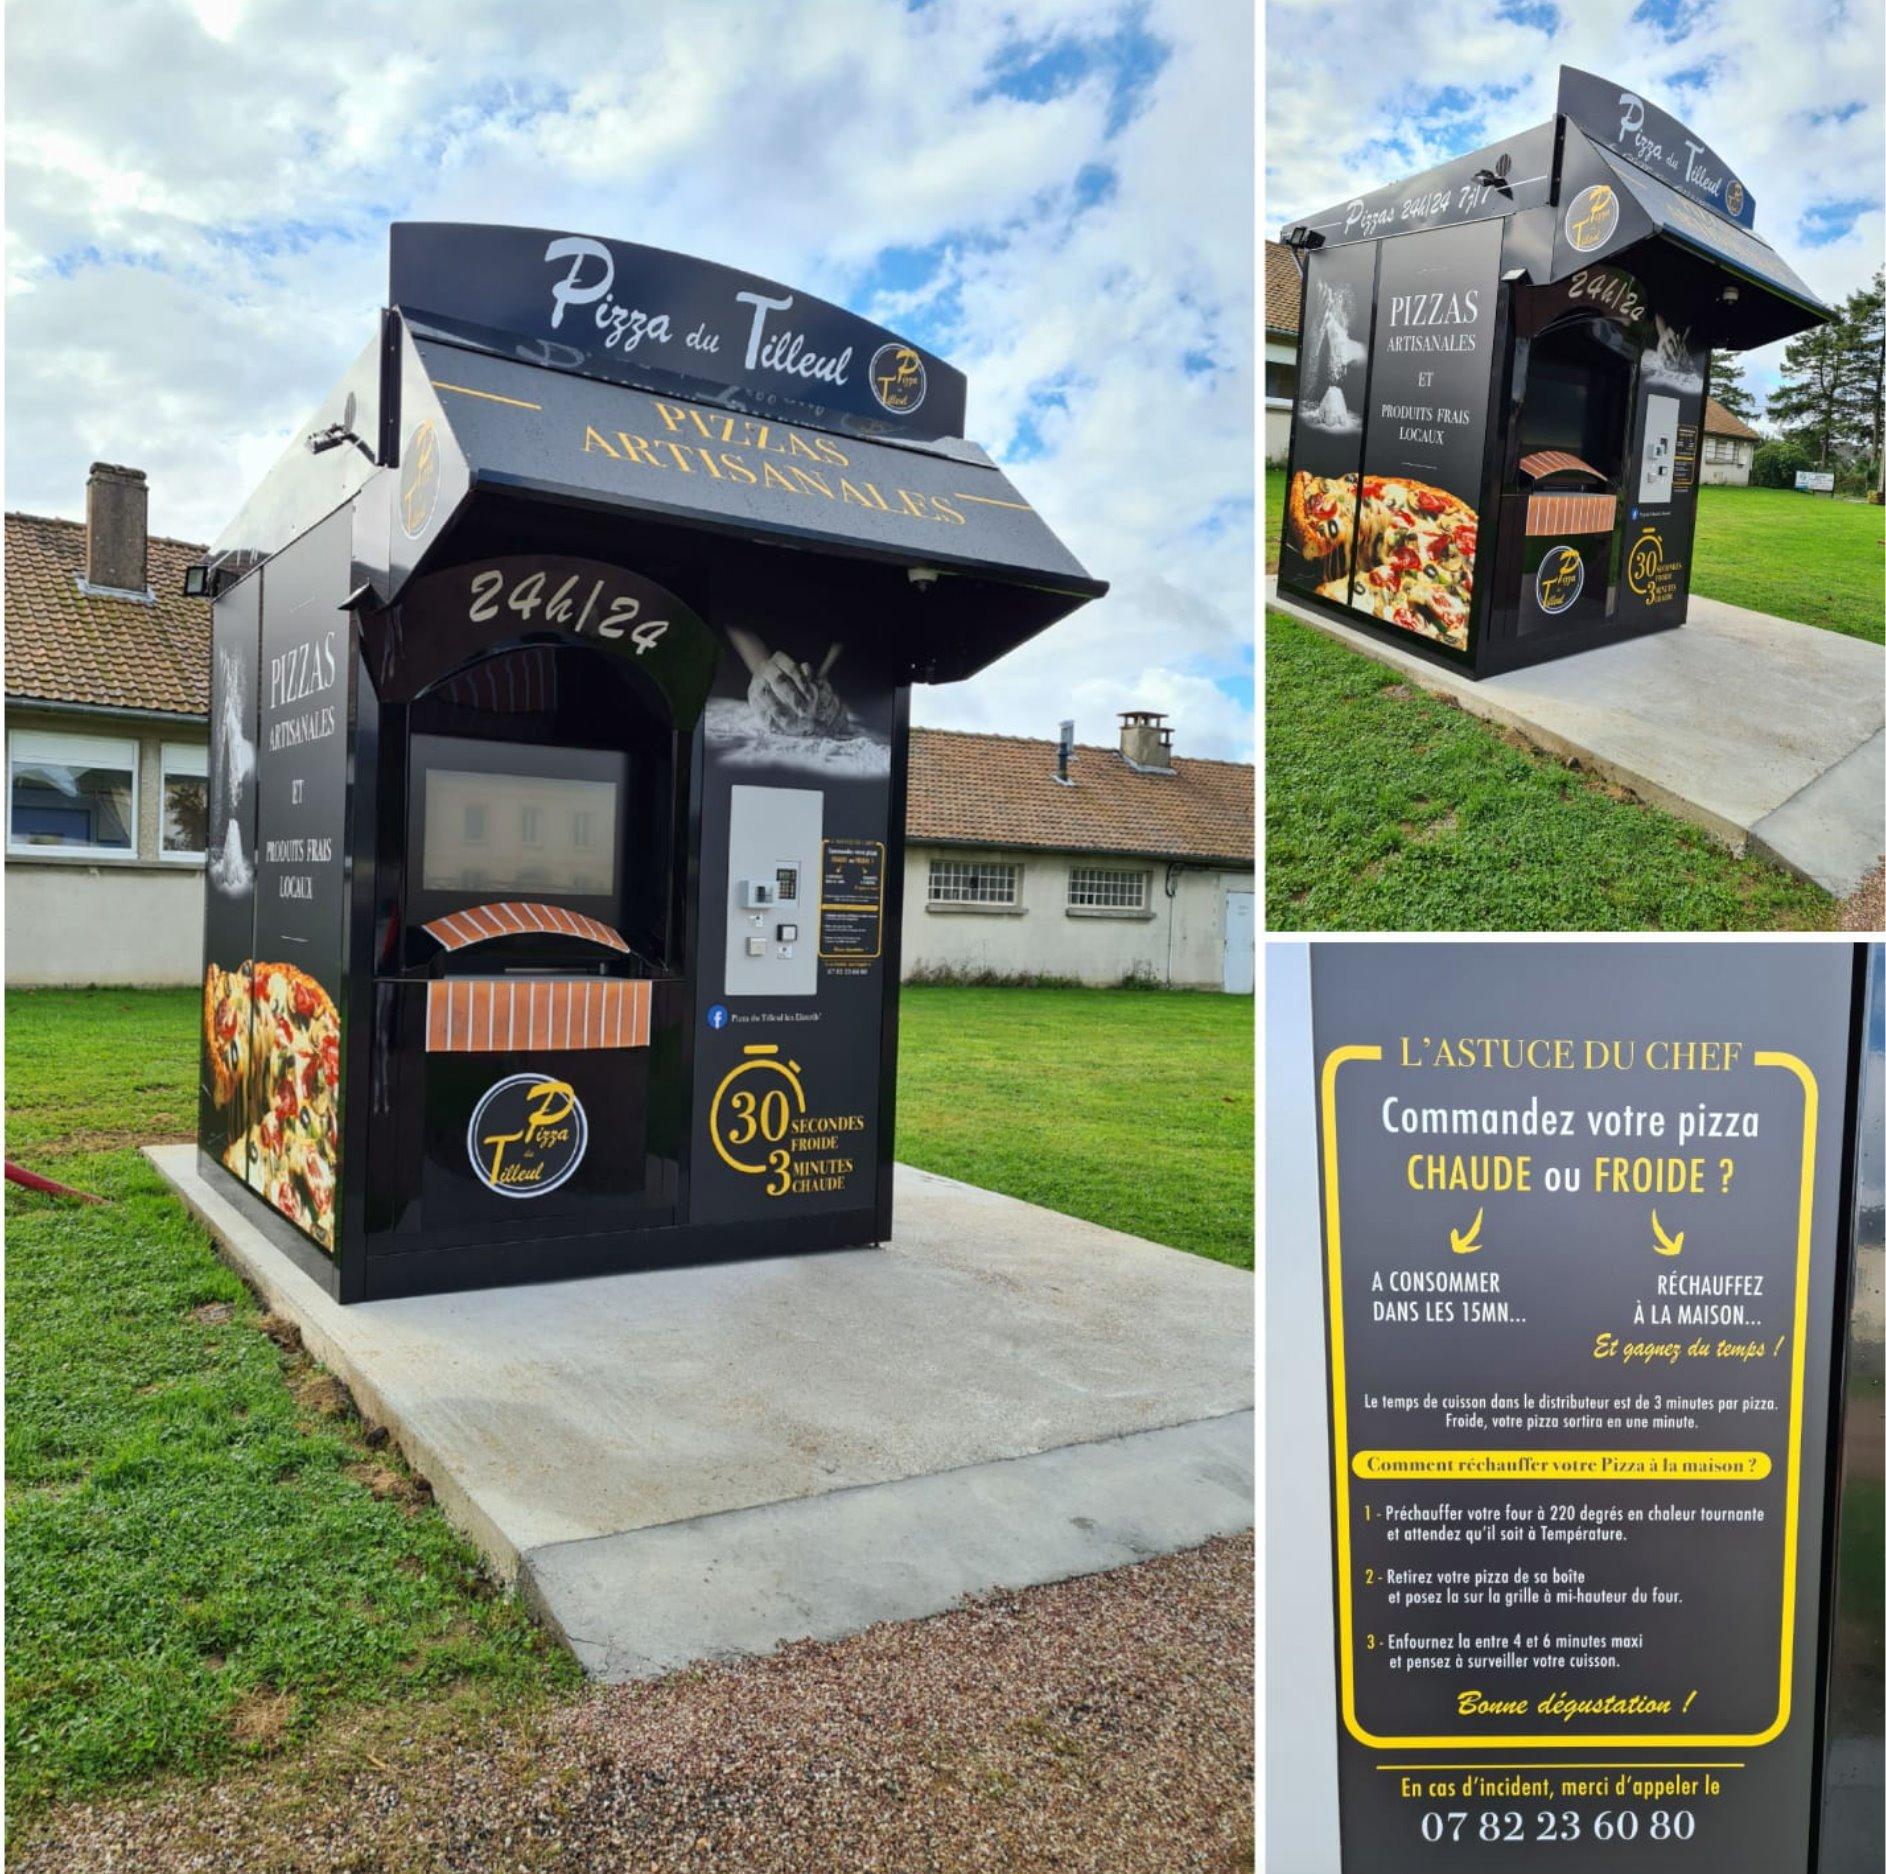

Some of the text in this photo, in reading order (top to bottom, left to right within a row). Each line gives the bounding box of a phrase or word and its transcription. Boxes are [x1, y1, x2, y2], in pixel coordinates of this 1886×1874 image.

[1619, 93, 1723, 197] Pizza du Tilleul
[1344, 198, 1395, 237] Pizzas
[545, 237, 853, 386] Pizza du Tilleul
[1390, 290, 1479, 327] PIZZAS
[1387, 334, 1476, 352] ARTISANALES
[1418, 372, 1434, 387] ET
[1381, 404, 1470, 425] PRODUITS FRAIS
[654, 402, 850, 467] PIZZAS
[1399, 427, 1444, 445] LOCAUX
[582, 425, 967, 526] ARTISANALES
[1635, 551, 1658, 579] 30
[1645, 581, 1656, 605] 3
[469, 569, 670, 655] 24h/24
[270, 631, 336, 709] PIZZAS
[269, 705, 336, 751] ARTISANALES
[291, 779, 305, 805] ET
[266, 838, 332, 863] PRODUITS FRAIS
[279, 875, 313, 900] LOCAUX
[1585, 1041, 1633, 1069] DU
[1646, 1042, 1742, 1070] CHEF
[526, 1081, 575, 1149] Pizza
[728, 1090, 790, 1144] 30
[791, 1115, 865, 1134] SECONDES
[1383, 1096, 1759, 1146] Commandez votre pizza
[791, 1136, 839, 1152] FROIDE
[484, 1130, 545, 1185] Tilleul
[792, 1158, 854, 1177] MINUTES
[766, 1149, 792, 1196] 3
[792, 1176, 846, 1194] CHAUDE
[1408, 1155, 1733, 1193] CHAUDE ou FROIDE ?
[1372, 1271, 1500, 1292] A CONSOMMER
[1658, 1271, 1763, 1295] RÉCHAUFFEZ
[1374, 1301, 1525, 1322] DANS LES 15MN...
[1634, 1300, 1761, 1325] À LA MAISON...
[1594, 1333, 1785, 1363] Et gagnez du temps !
[1365, 1393, 1778, 1413] Le temps de cuisson dans le distributeur est de 3 minutes par pizza.
[1446, 1412, 1698, 1430] Froide, votre pizza sortira en une minute.
[1367, 1454, 1758, 1473] Comment réchauffer votre Pizza à la maison ?
[1365, 1504, 1764, 1527] 1 Préchauffer votre four à 220 degrés en chaleur tournante
[1387, 1528, 1399, 1541] et
[1405, 1525, 1460, 1541] attendez
[1501, 1526, 1523, 1540] soit
[1528, 1526, 1536, 1540] à
[1541, 1526, 1627, 1544] Température.
[1366, 1567, 1585, 1588] 2 Retirez votre pizza de sa boîte
[1389, 1587, 1682, 1607] et posez la sur la grille à mi-hauteur du four.
[1367, 1633, 1642, 1649] 3 Enfournez la entre 4 et 6 minutes maxi
[1390, 1652, 1620, 1672] et pensez à surveiller votre cuisson.
[1458, 1690, 1697, 1722] Bonne dégustation !
[1402, 1778, 1421, 1797] En
[1429, 1783, 1455, 1797] cas
[1562, 1777, 1608, 1795] merci
[1705, 1774, 1720, 1795] le
[1422, 1811, 1695, 1841] 07 82 23 60 80
